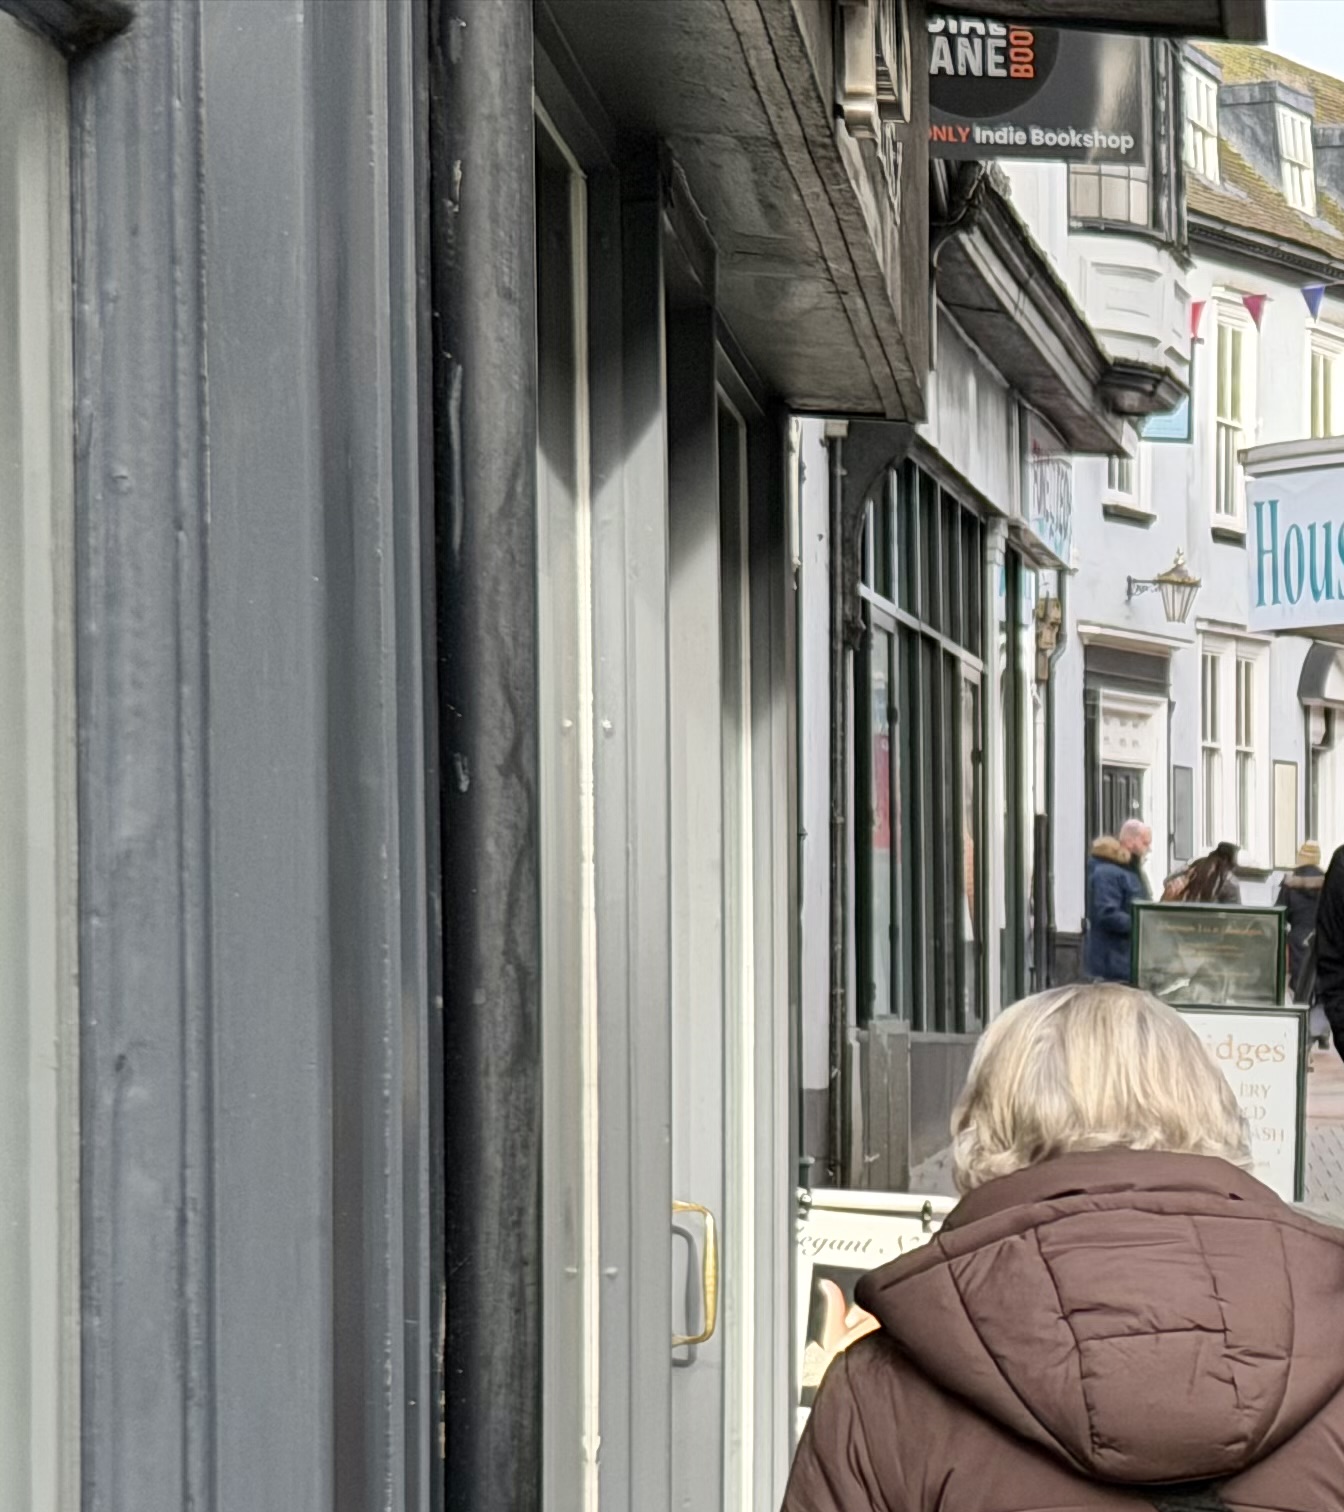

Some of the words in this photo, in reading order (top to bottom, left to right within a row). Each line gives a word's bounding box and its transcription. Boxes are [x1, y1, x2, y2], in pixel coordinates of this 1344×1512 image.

[929, 35, 1008, 77] ANE
[1009, 24, 1035, 79] BOO
[929, 125, 971, 143] NLY
[975, 126, 1028, 146] Indie
[1031, 128, 1135, 154] Bookshop
